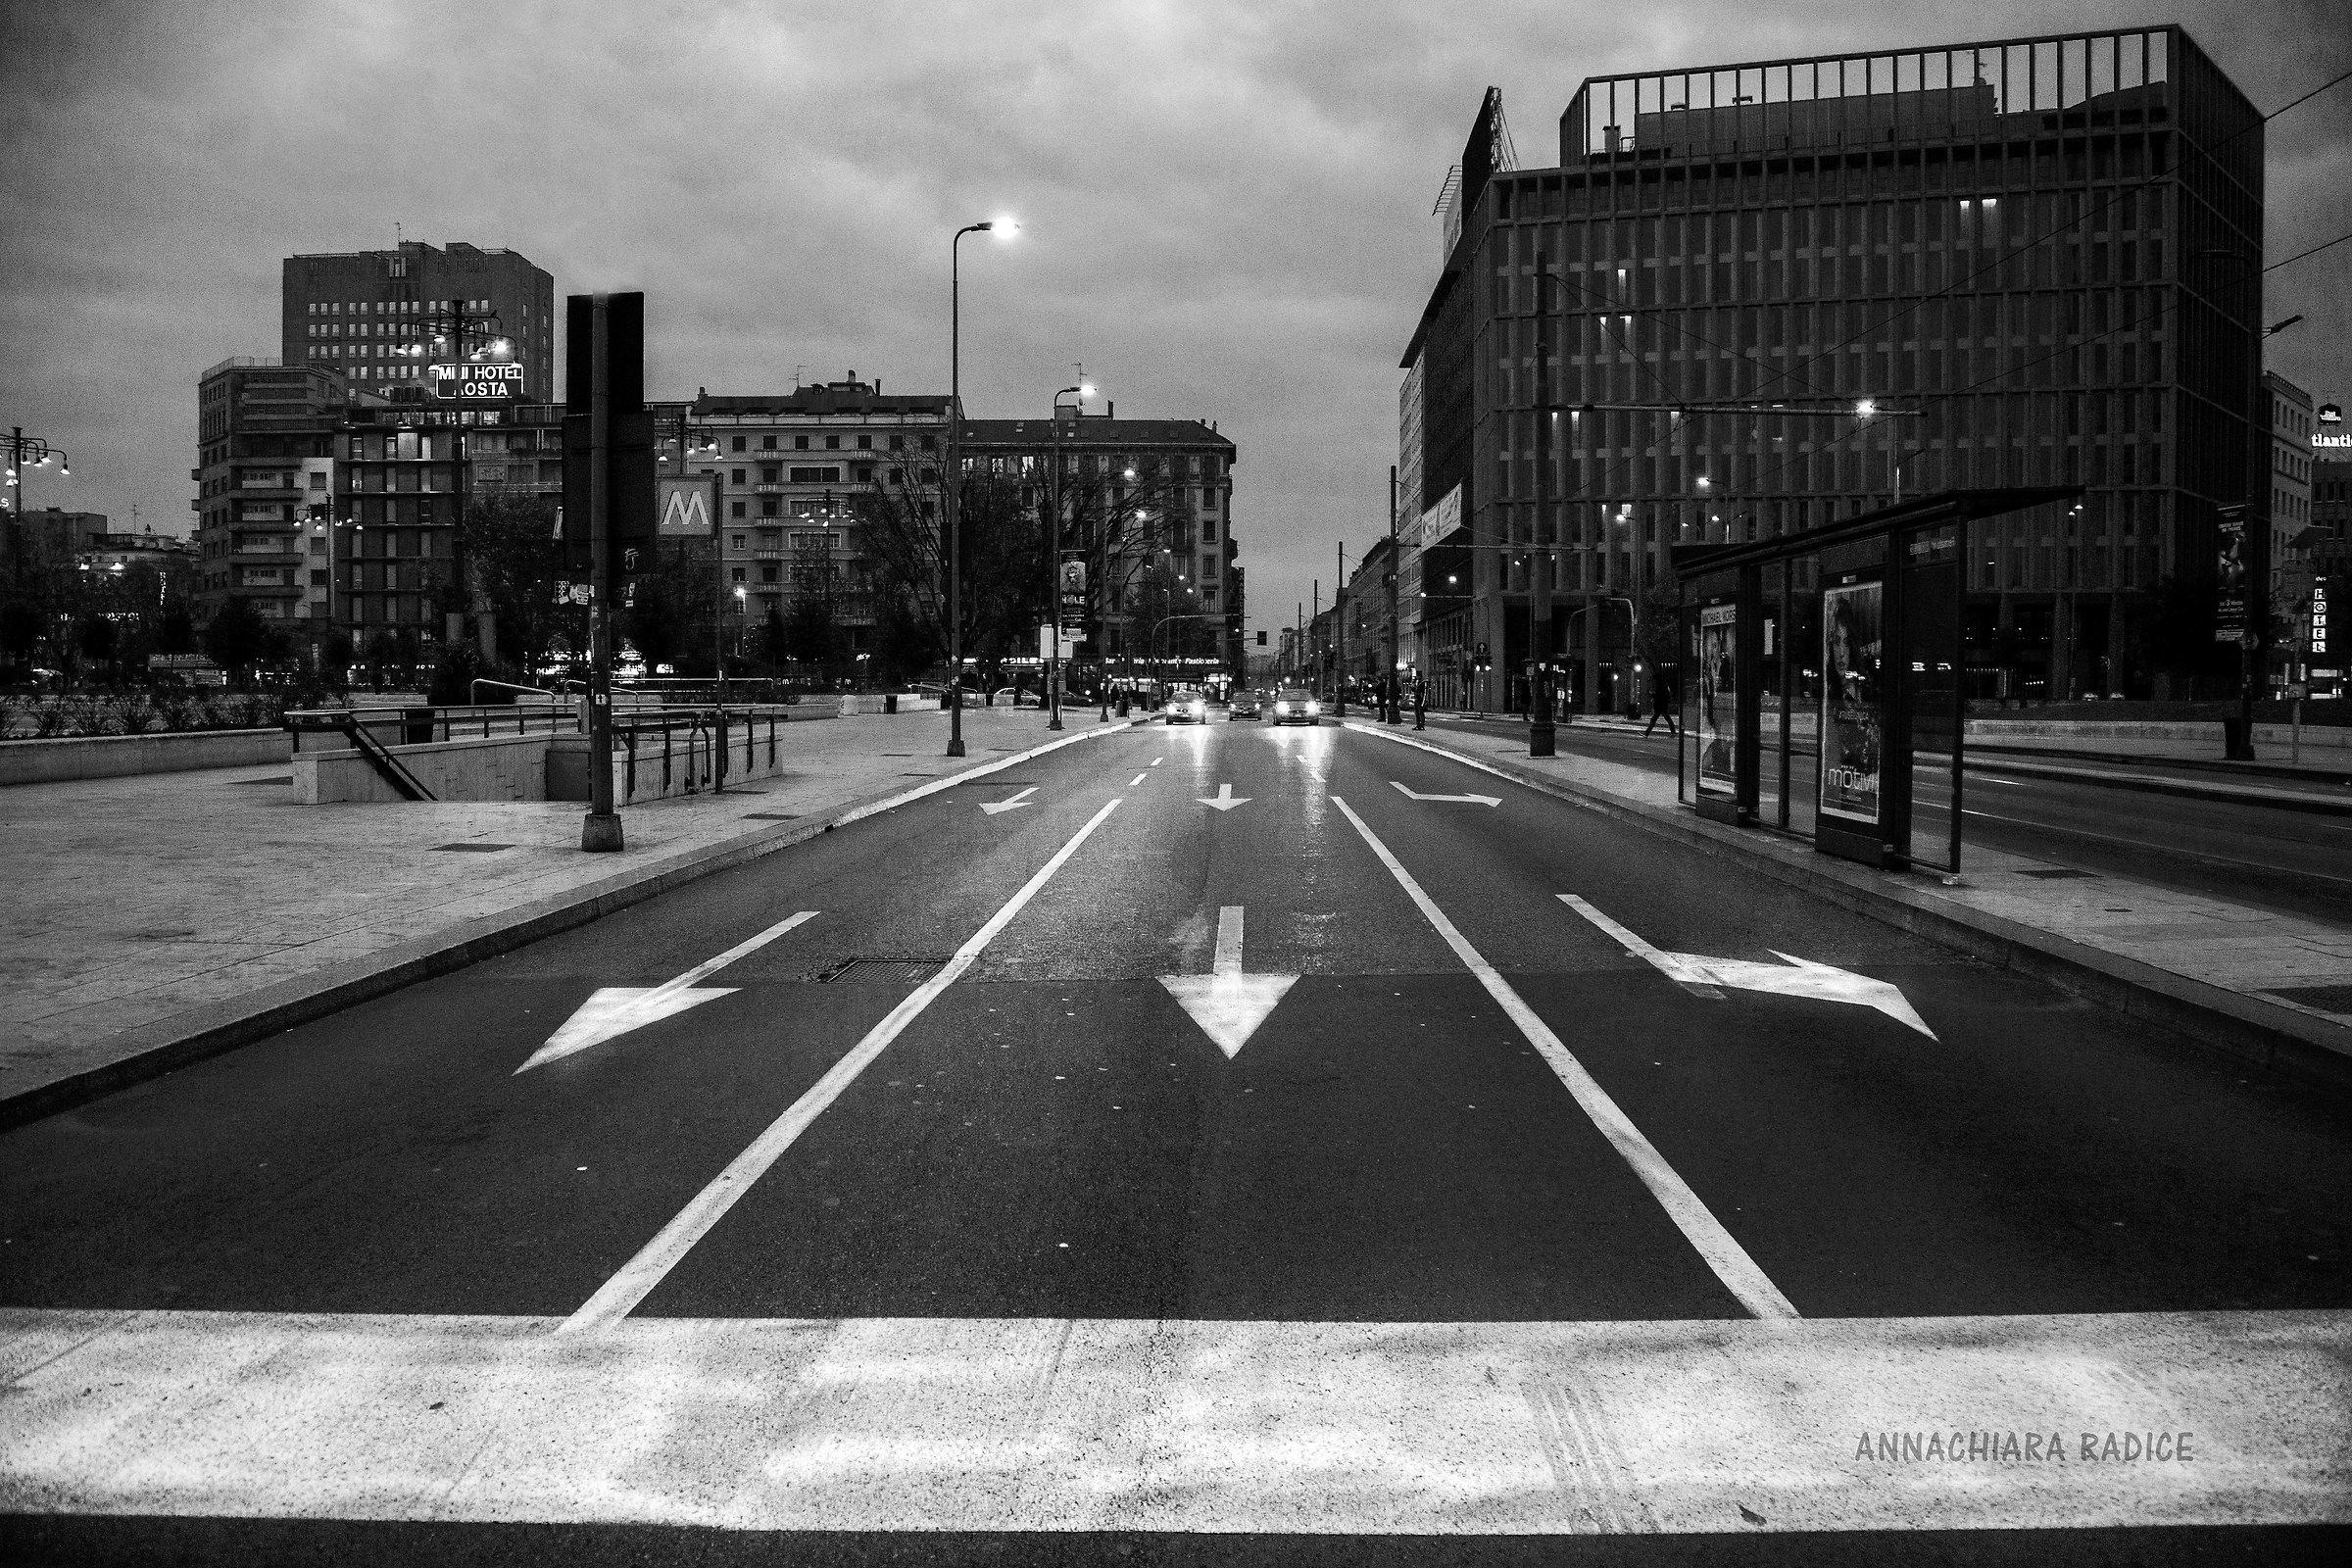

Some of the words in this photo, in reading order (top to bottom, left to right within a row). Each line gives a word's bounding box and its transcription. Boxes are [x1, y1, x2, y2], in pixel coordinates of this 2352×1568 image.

[438, 366, 468, 380] MII
[474, 366, 521, 380] HOTEL
[2311, 433, 2352, 447] tlanti
[662, 490, 710, 525] M
[2314, 589, 2326, 653] HOTEL
